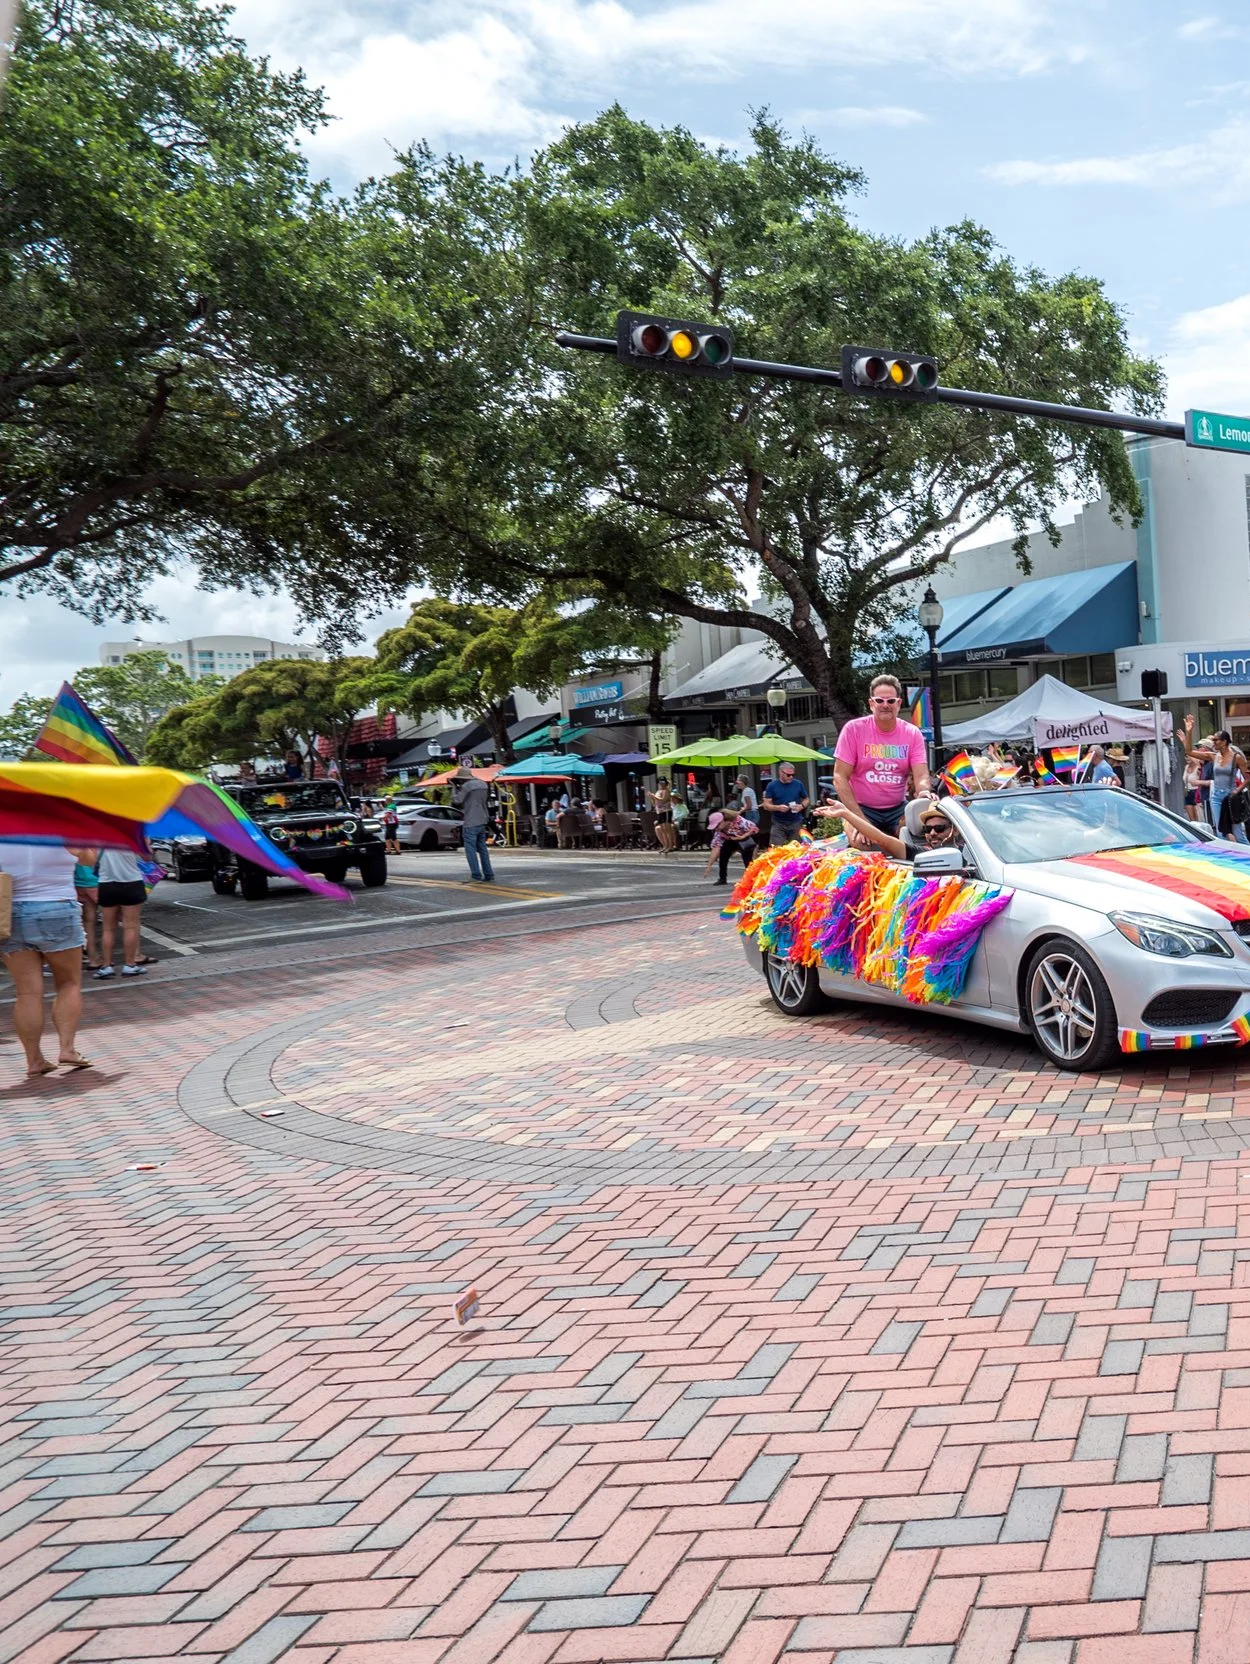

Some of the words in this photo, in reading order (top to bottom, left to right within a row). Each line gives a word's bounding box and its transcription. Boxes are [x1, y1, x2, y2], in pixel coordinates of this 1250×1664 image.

[965, 648, 1007, 662] bluemercury
[1200, 676, 1237, 685] makeup
[1046, 721, 1109, 740] delighted
[655, 743, 671, 756] 15
[863, 743, 908, 759] PROUDLY
